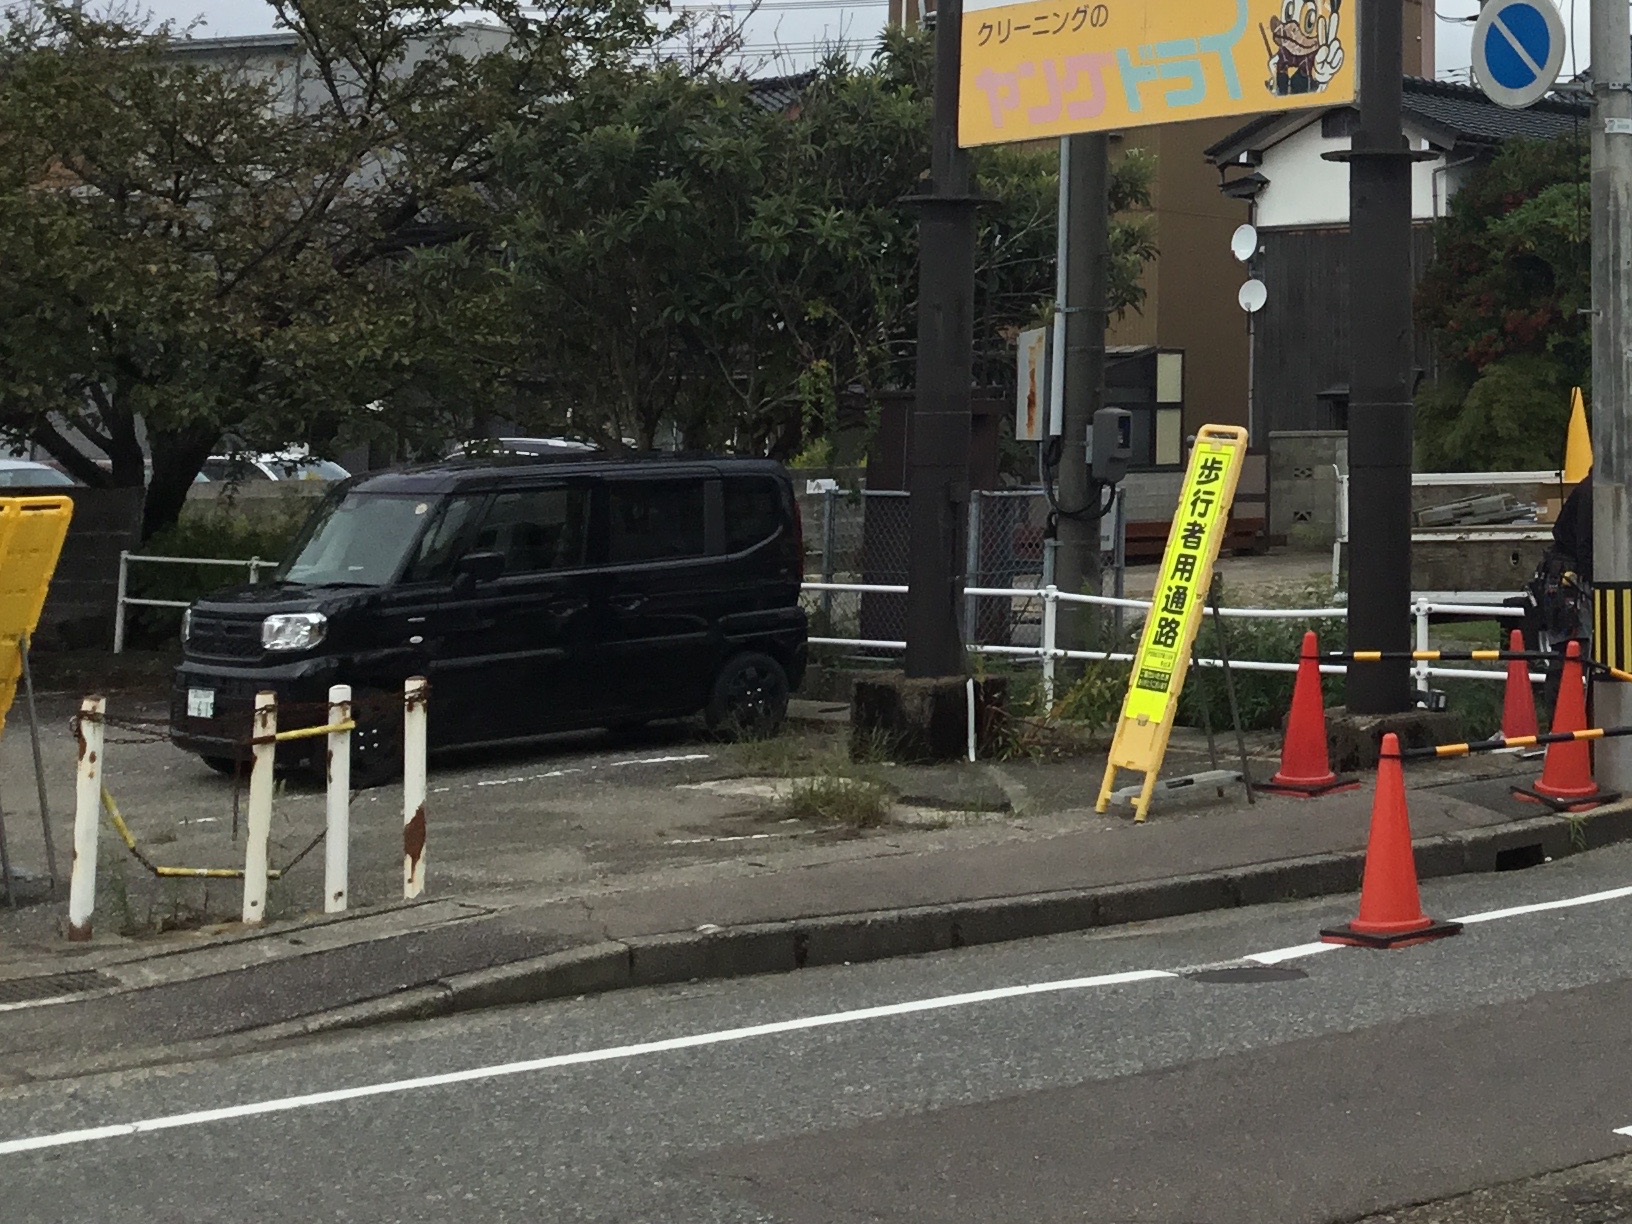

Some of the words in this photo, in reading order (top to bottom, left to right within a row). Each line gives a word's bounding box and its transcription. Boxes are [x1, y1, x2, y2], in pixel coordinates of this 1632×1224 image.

[977, 4, 1109, 47] クリーニングの
[1152, 456, 1224, 650] 歩行者用通路
